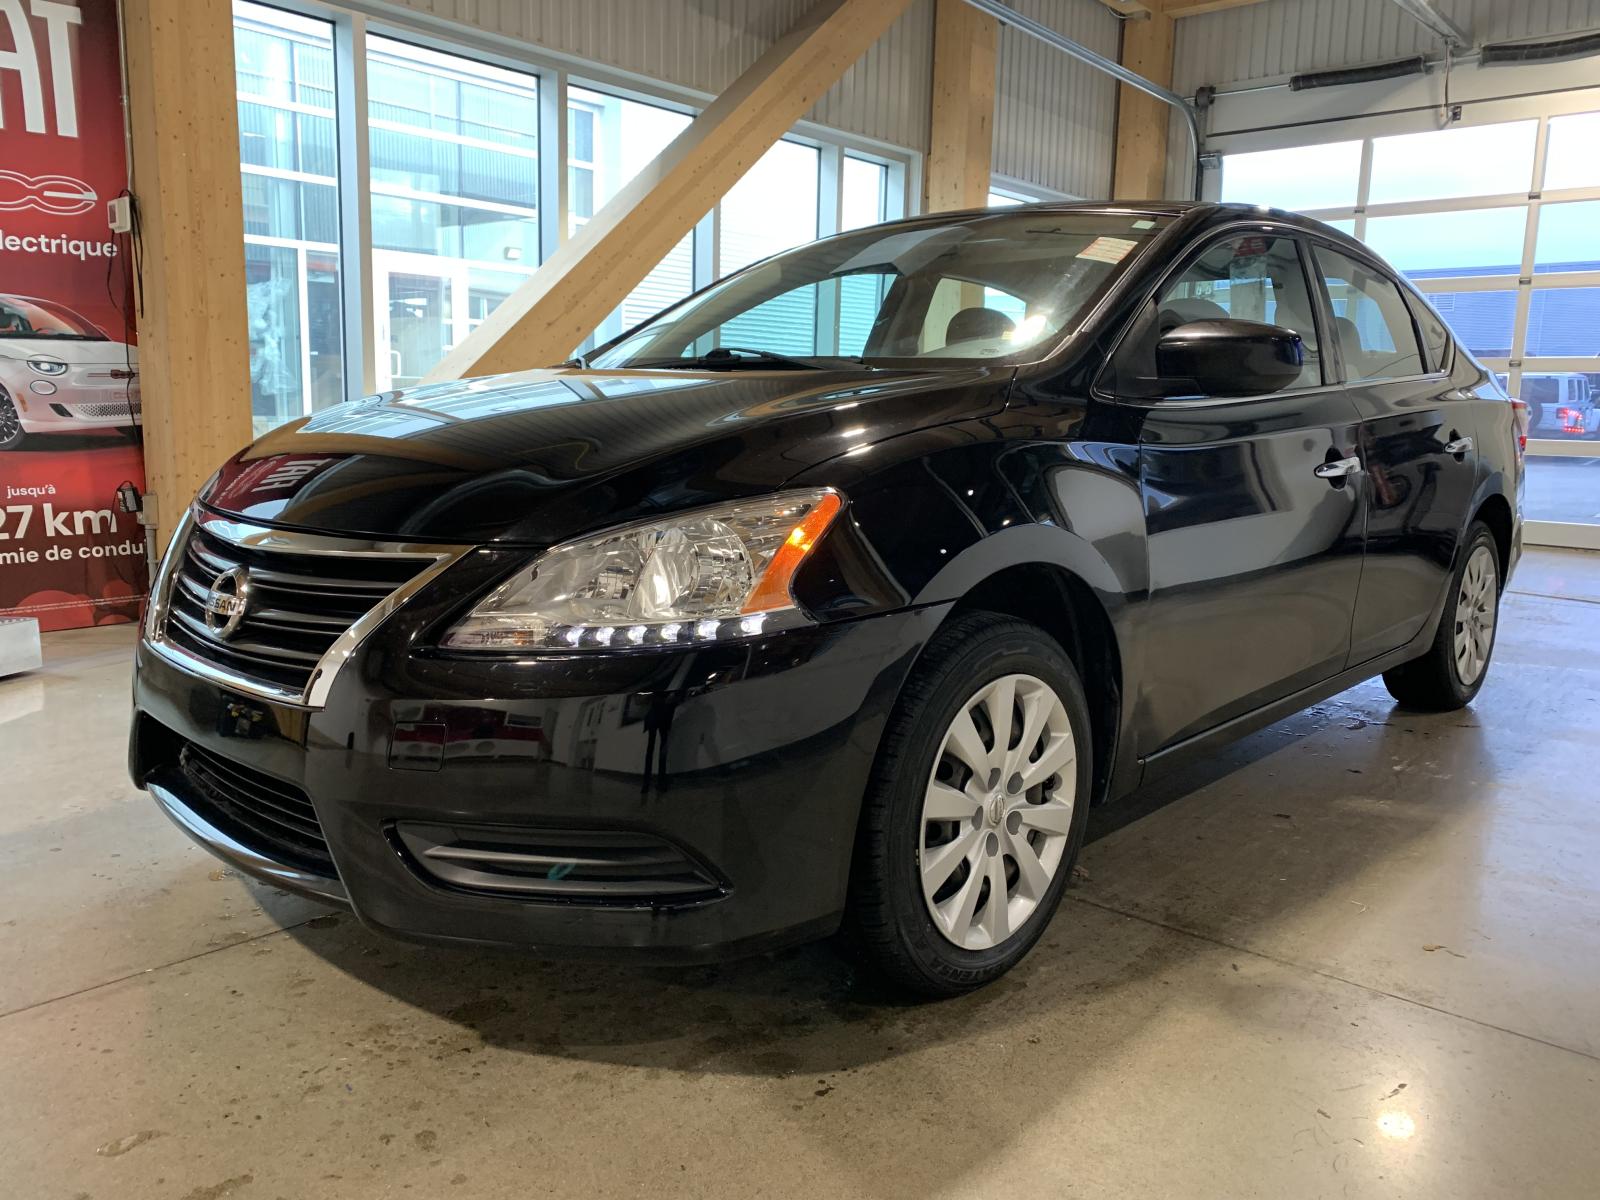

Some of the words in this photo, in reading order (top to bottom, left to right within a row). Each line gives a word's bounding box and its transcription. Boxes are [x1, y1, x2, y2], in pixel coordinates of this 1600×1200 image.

[7, 485, 56, 499] jusqu'à
[42, 502, 118, 536] km
[45, 544, 72, 562] de
[78, 538, 147, 559] condu
